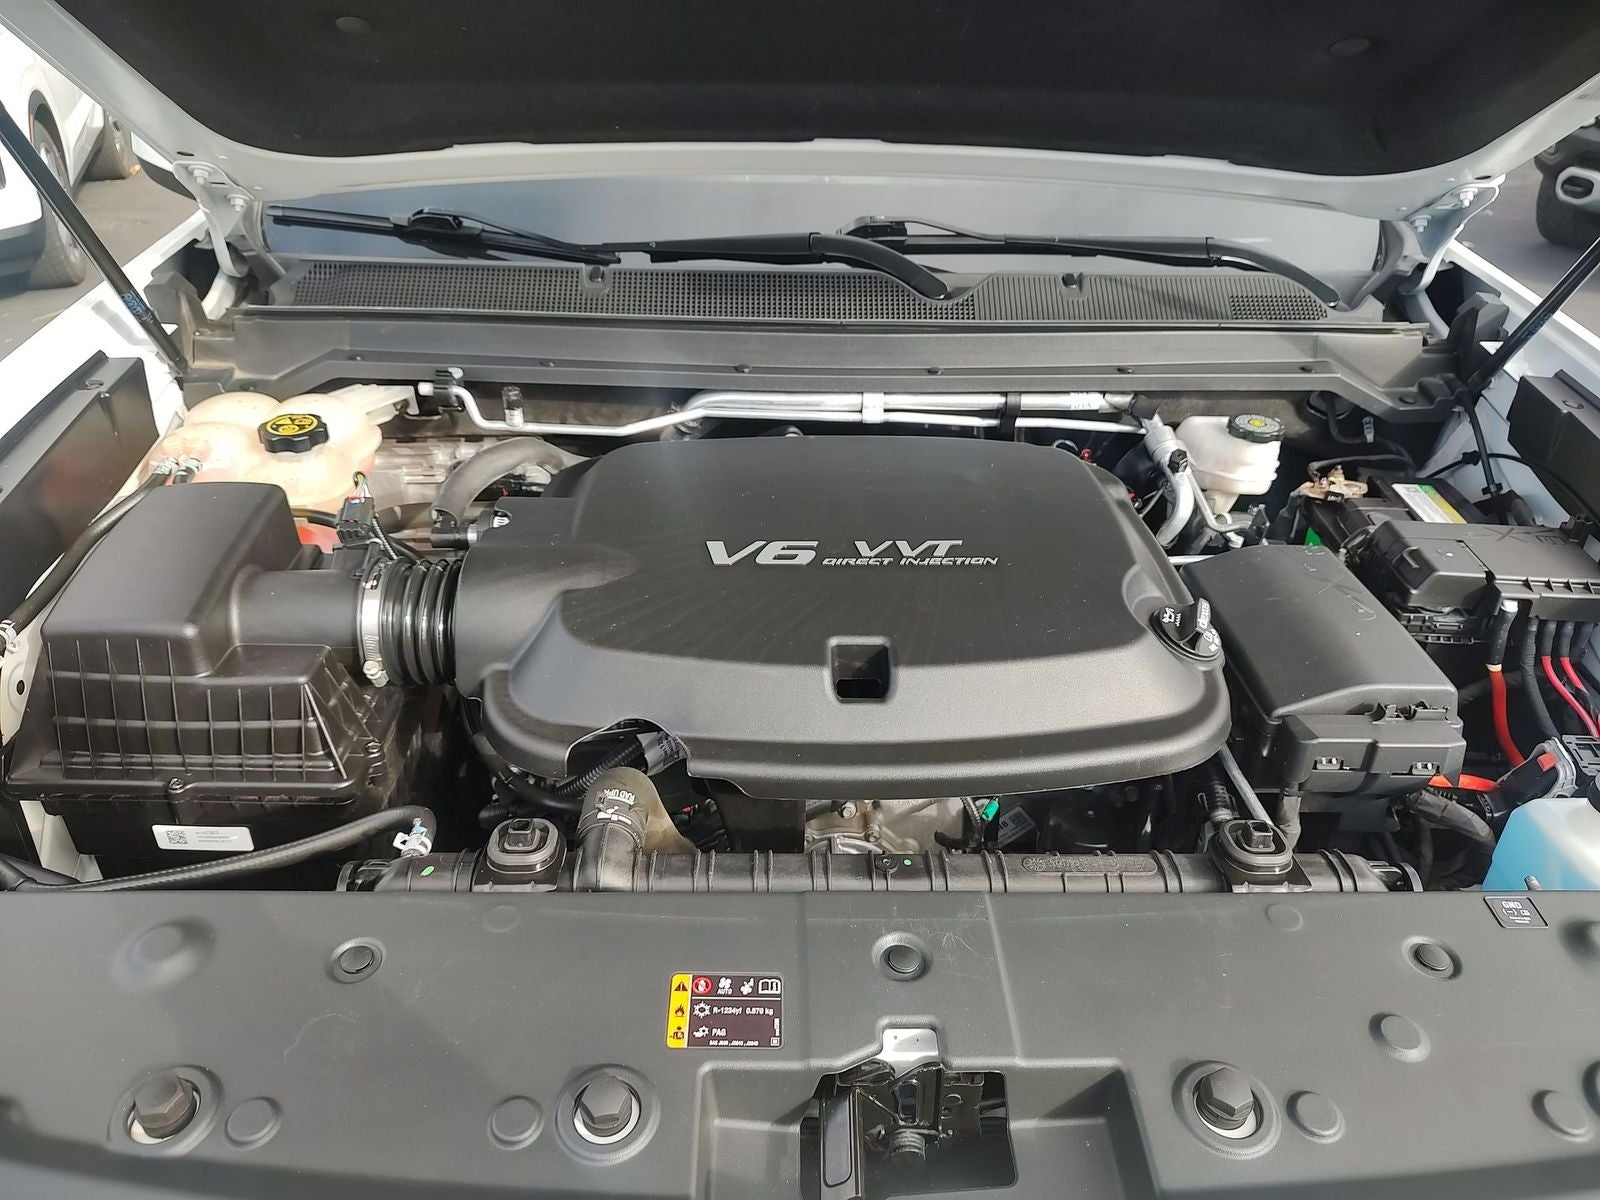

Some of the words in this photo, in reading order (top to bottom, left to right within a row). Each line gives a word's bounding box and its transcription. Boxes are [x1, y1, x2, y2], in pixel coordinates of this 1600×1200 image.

[705, 540, 819, 566] V6
[853, 540, 963, 558] VVT
[821, 557, 894, 566] DIRECT
[899, 557, 998, 566] INJECTION
[765, 1007, 774, 1016] kg
[711, 1028, 727, 1037] PAG
